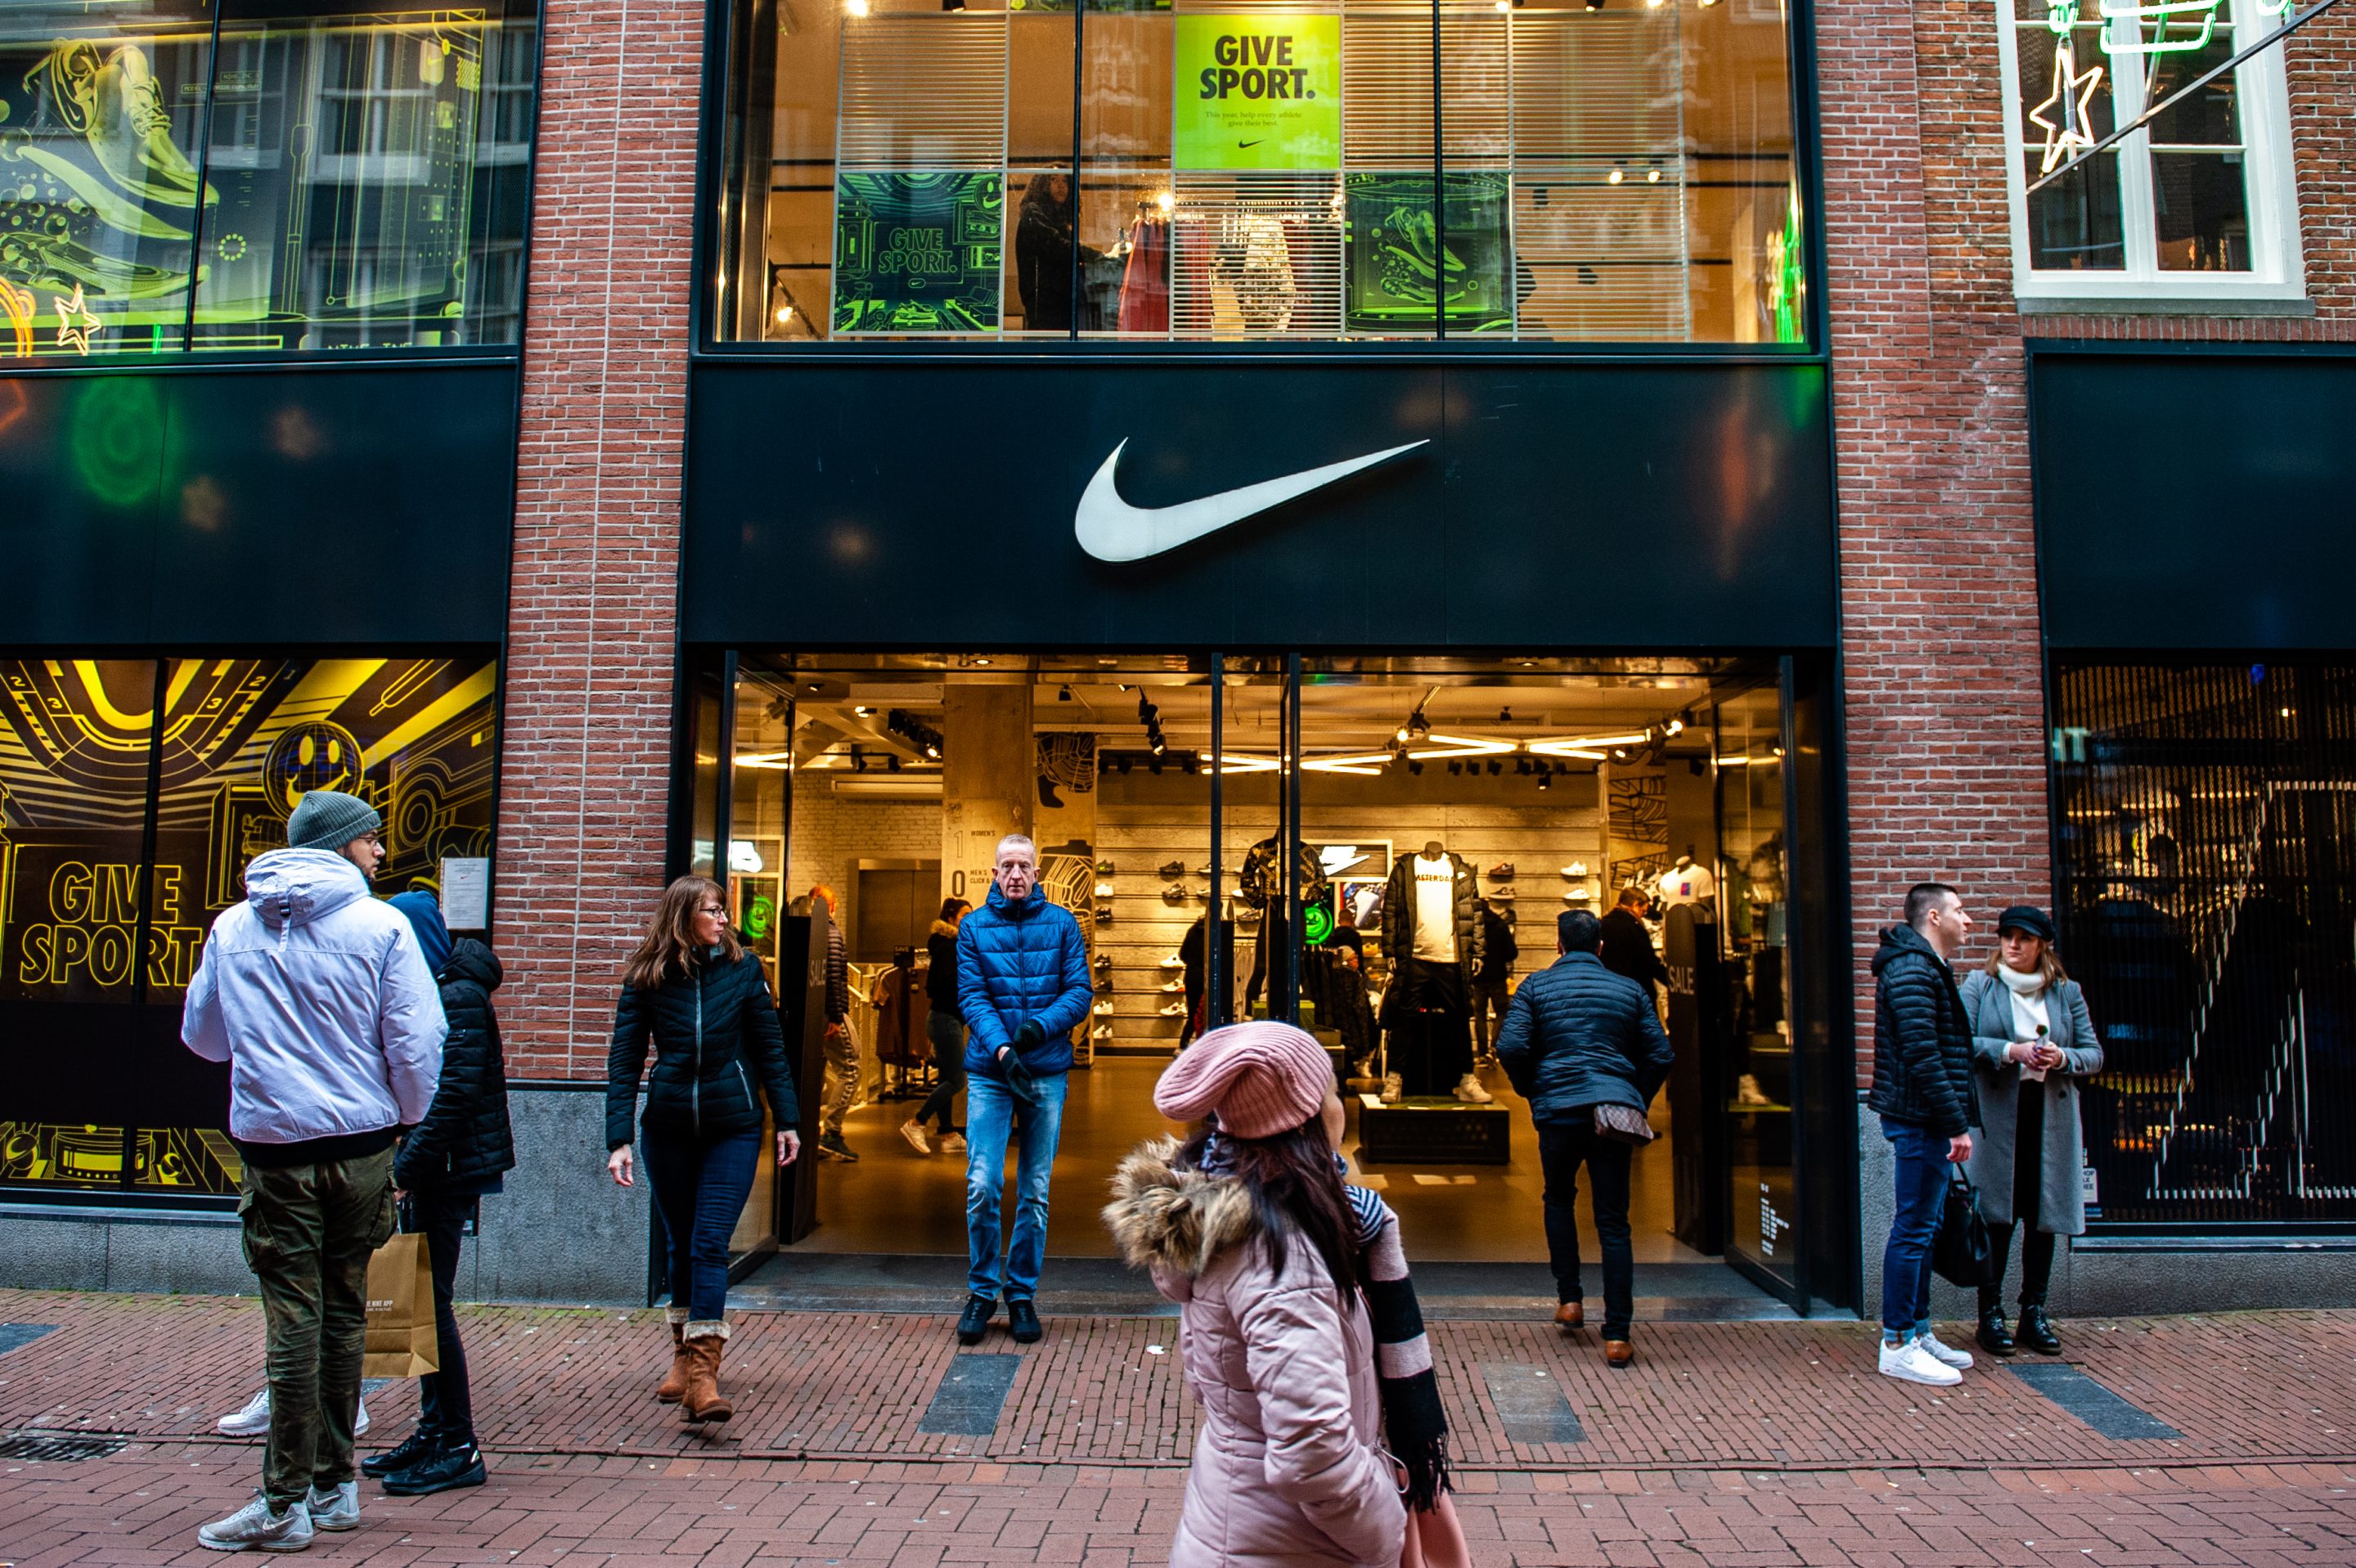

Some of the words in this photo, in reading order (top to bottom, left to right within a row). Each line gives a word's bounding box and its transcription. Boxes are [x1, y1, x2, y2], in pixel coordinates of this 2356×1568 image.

[1215, 35, 1293, 65] GIVE
[1200, 68, 1315, 99] SPORT.
[1240, 111, 1256, 119] help
[889, 227, 943, 251] GIVE
[879, 250, 958, 273] SPORT.
[10, 676, 25, 687] 2
[250, 676, 267, 687] 2
[47, 698, 62, 709] 3
[207, 698, 223, 709] 3
[954, 830, 963, 858] 1
[50, 861, 181, 923] GIVE
[952, 869, 965, 897] 0
[809, 959, 826, 987] SALE
[1669, 965, 1694, 995] SALE
